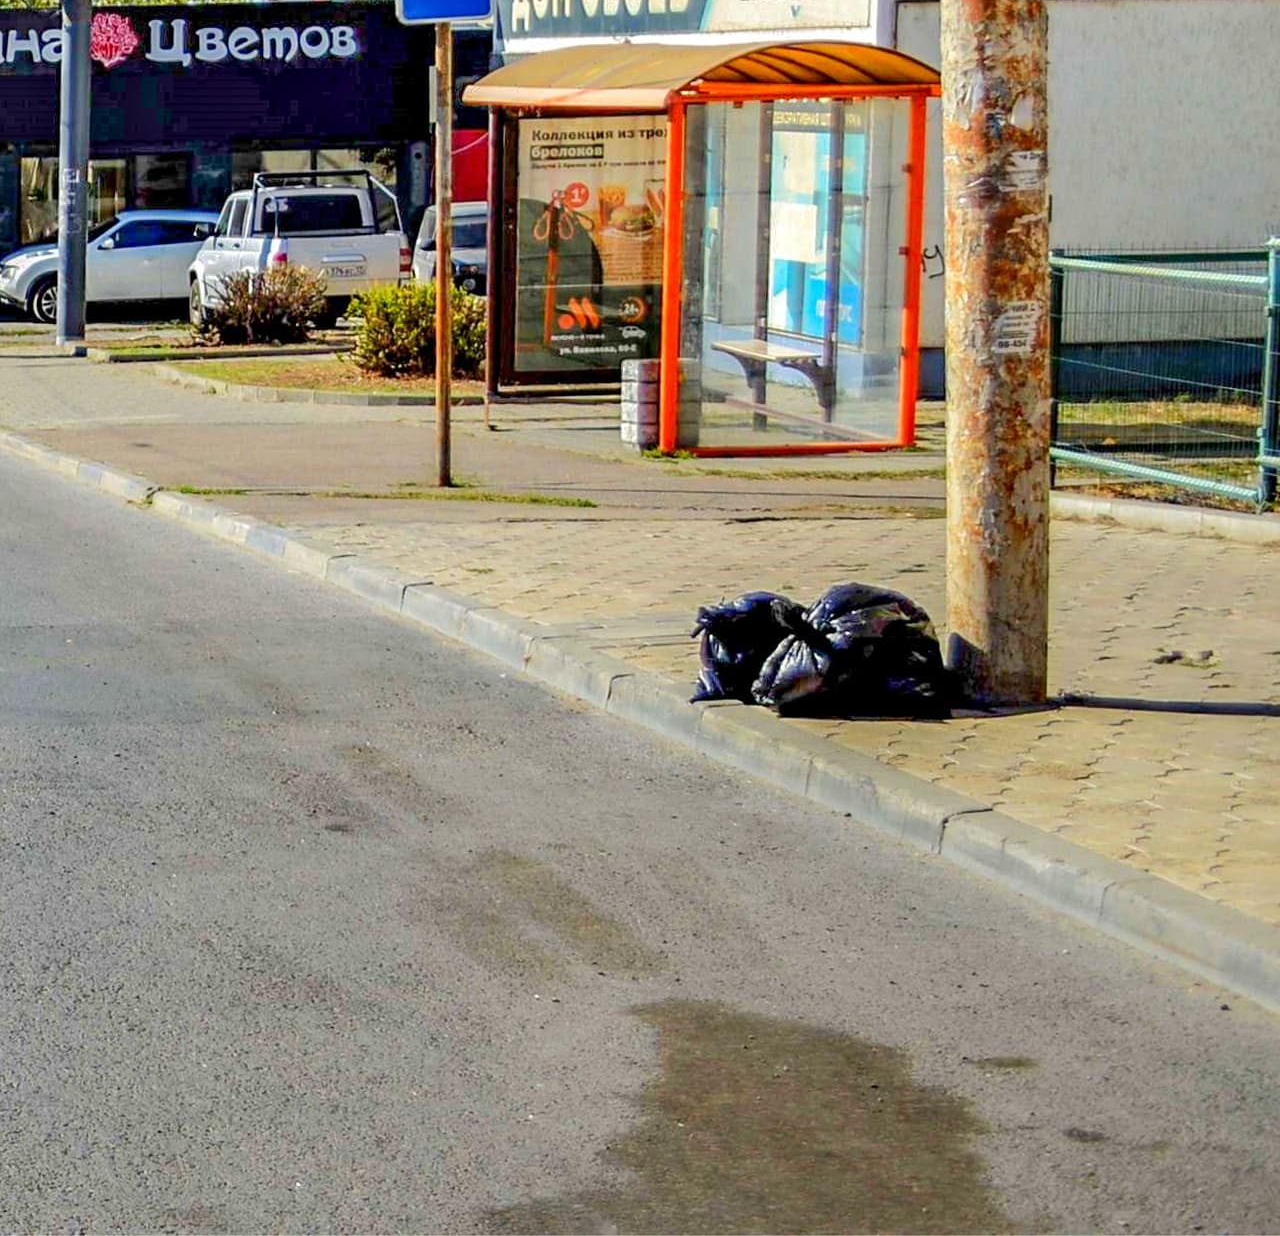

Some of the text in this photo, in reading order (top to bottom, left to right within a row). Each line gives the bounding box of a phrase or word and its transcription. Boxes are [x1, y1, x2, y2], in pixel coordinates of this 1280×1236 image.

[145, 18, 358, 67] Цветов
[532, 129, 613, 142] Коллекция
[618, 129, 635, 139] из
[531, 145, 604, 159] брелоков
